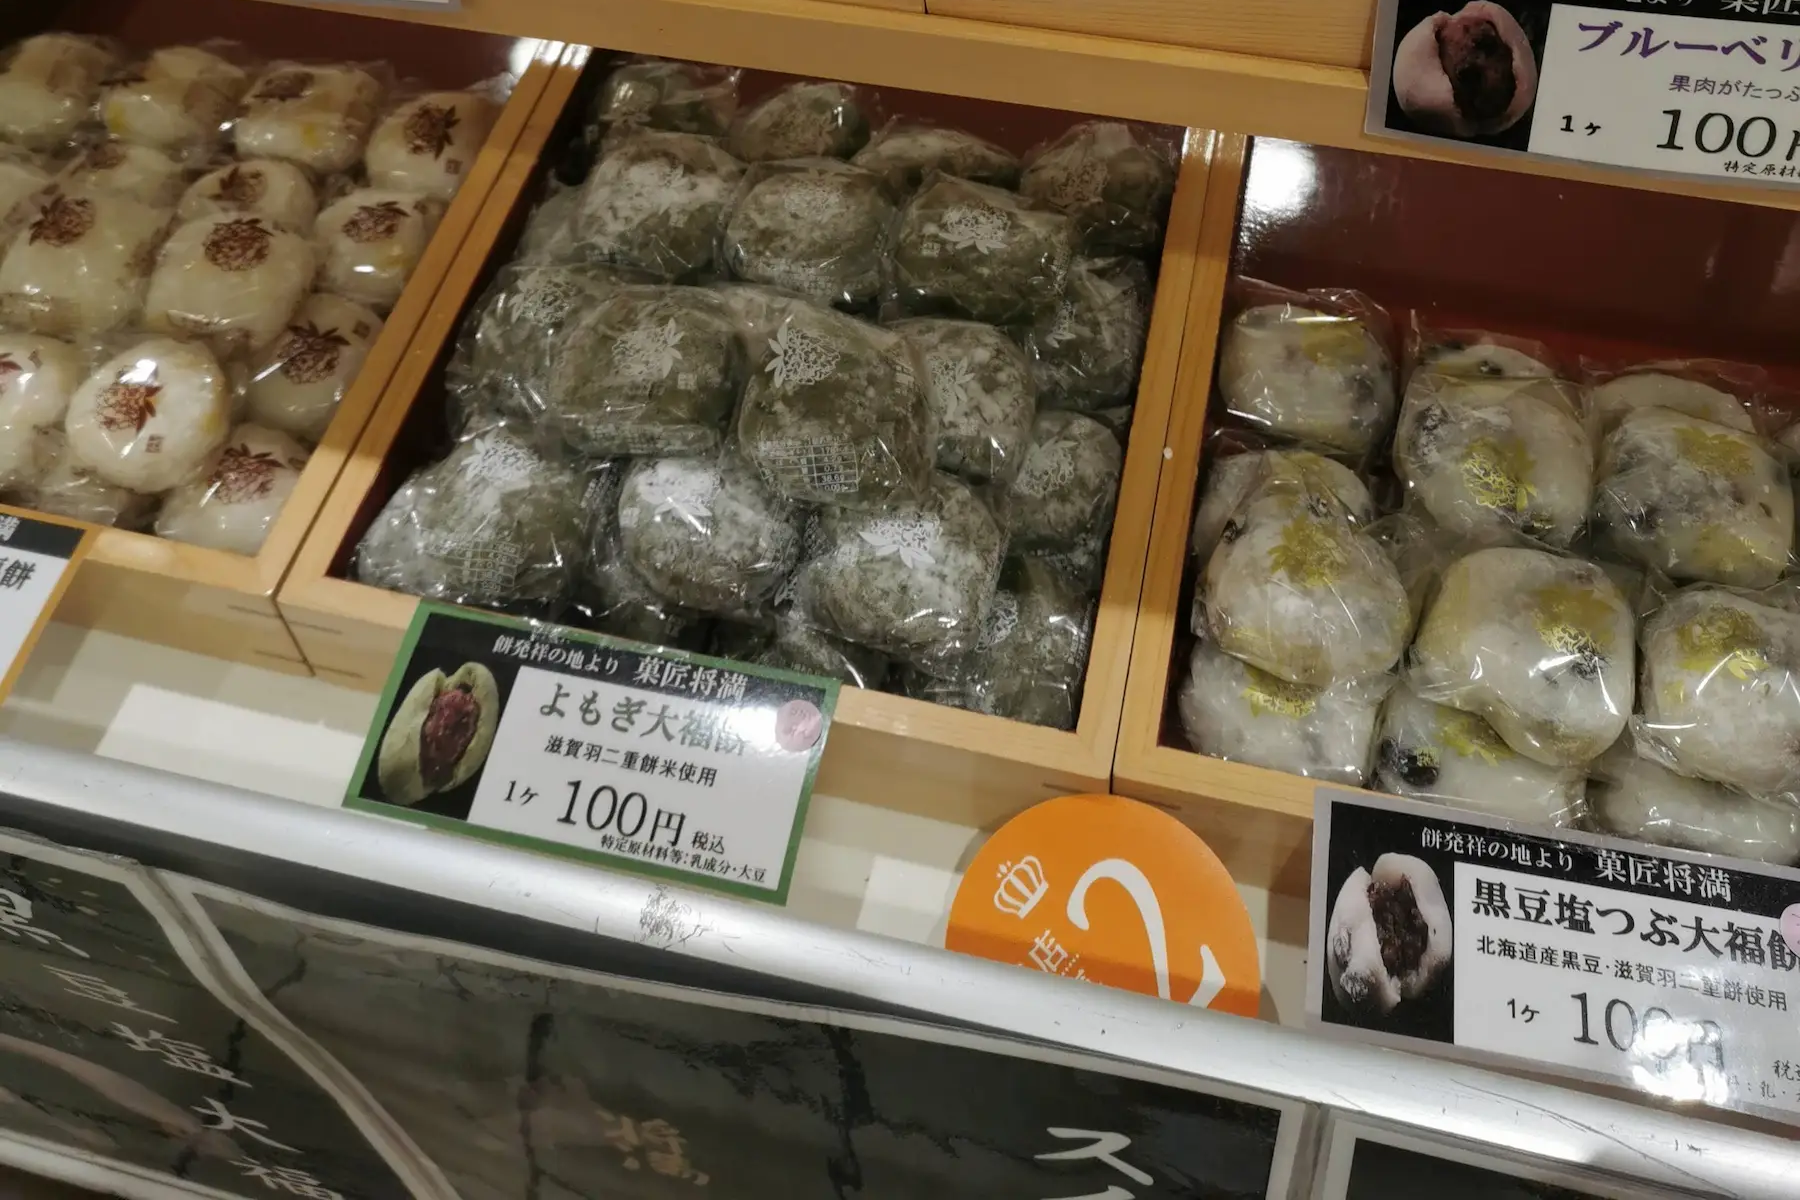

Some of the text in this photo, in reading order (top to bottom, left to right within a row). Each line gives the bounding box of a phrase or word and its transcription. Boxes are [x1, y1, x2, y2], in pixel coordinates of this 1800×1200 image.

[1724, 160, 1800, 178] 特定原材
[0, 556, 36, 591] 餅
[492, 635, 750, 700] 餅発祥の地より 菓匠将満
[543, 734, 719, 790] 滋賀羽二重餅米使用
[556, 779, 688, 848] 100円
[691, 829, 727, 856] 税込
[1421, 826, 1733, 903] 餅発祥の地より 菓匠将満
